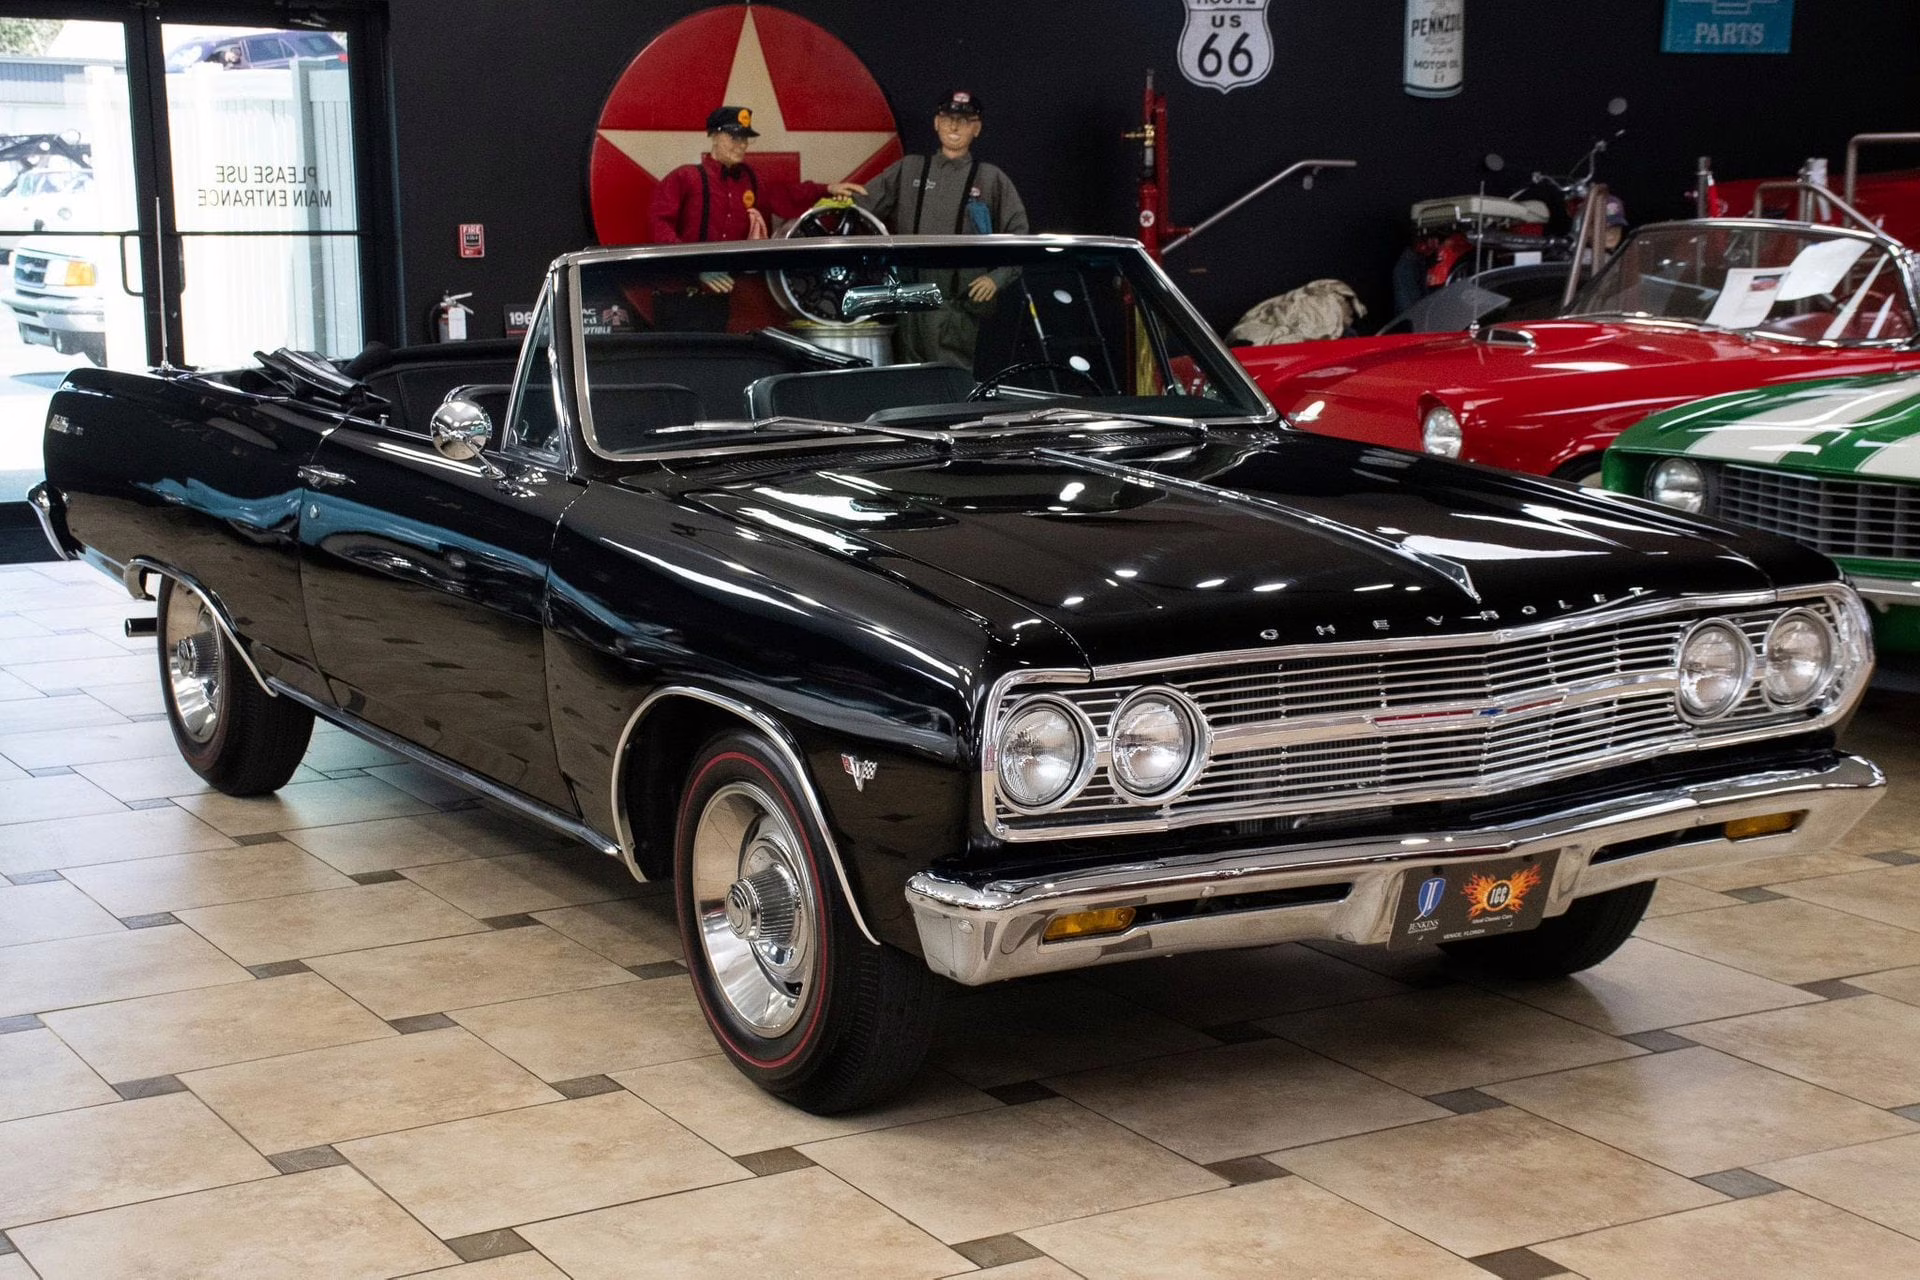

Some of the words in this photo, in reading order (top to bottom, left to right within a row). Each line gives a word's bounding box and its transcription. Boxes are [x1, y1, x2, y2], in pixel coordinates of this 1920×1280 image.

[1211, 14, 1242, 29] US
[1694, 22, 1764, 46] PARTS
[1197, 32, 1254, 78] 66
[508, 311, 533, 326] 196
[1260, 587, 1644, 640] CHEVROLET
